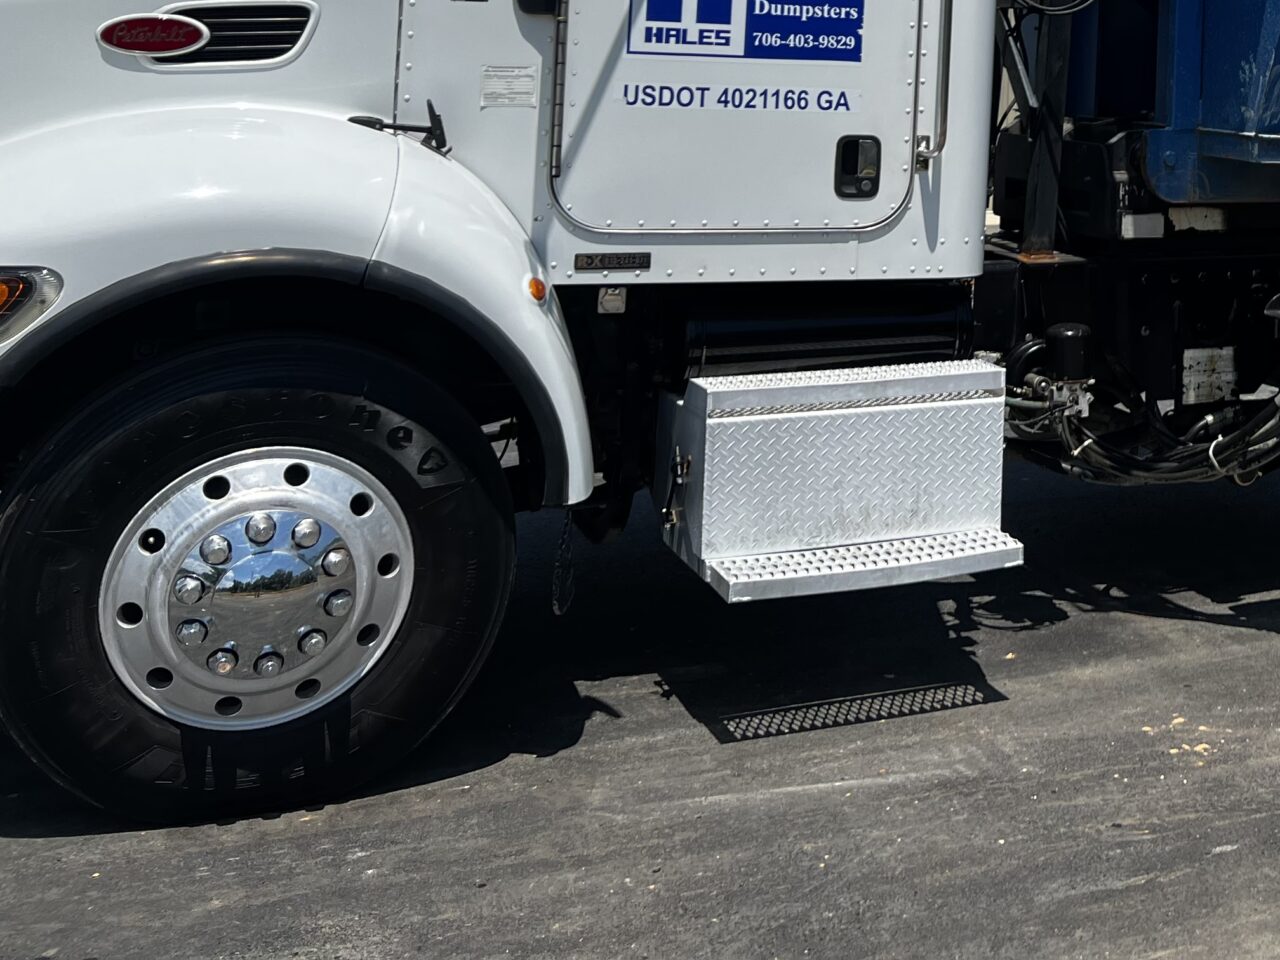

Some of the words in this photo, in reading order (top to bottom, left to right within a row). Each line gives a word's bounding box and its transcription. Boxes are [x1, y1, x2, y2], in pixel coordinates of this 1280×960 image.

[644, 26, 731, 46] HALES
[752, 32, 856, 49] 706-403-9829
[624, 84, 710, 108] USDOT
[717, 88, 809, 110] 4021166
[816, 90, 851, 111] GA
